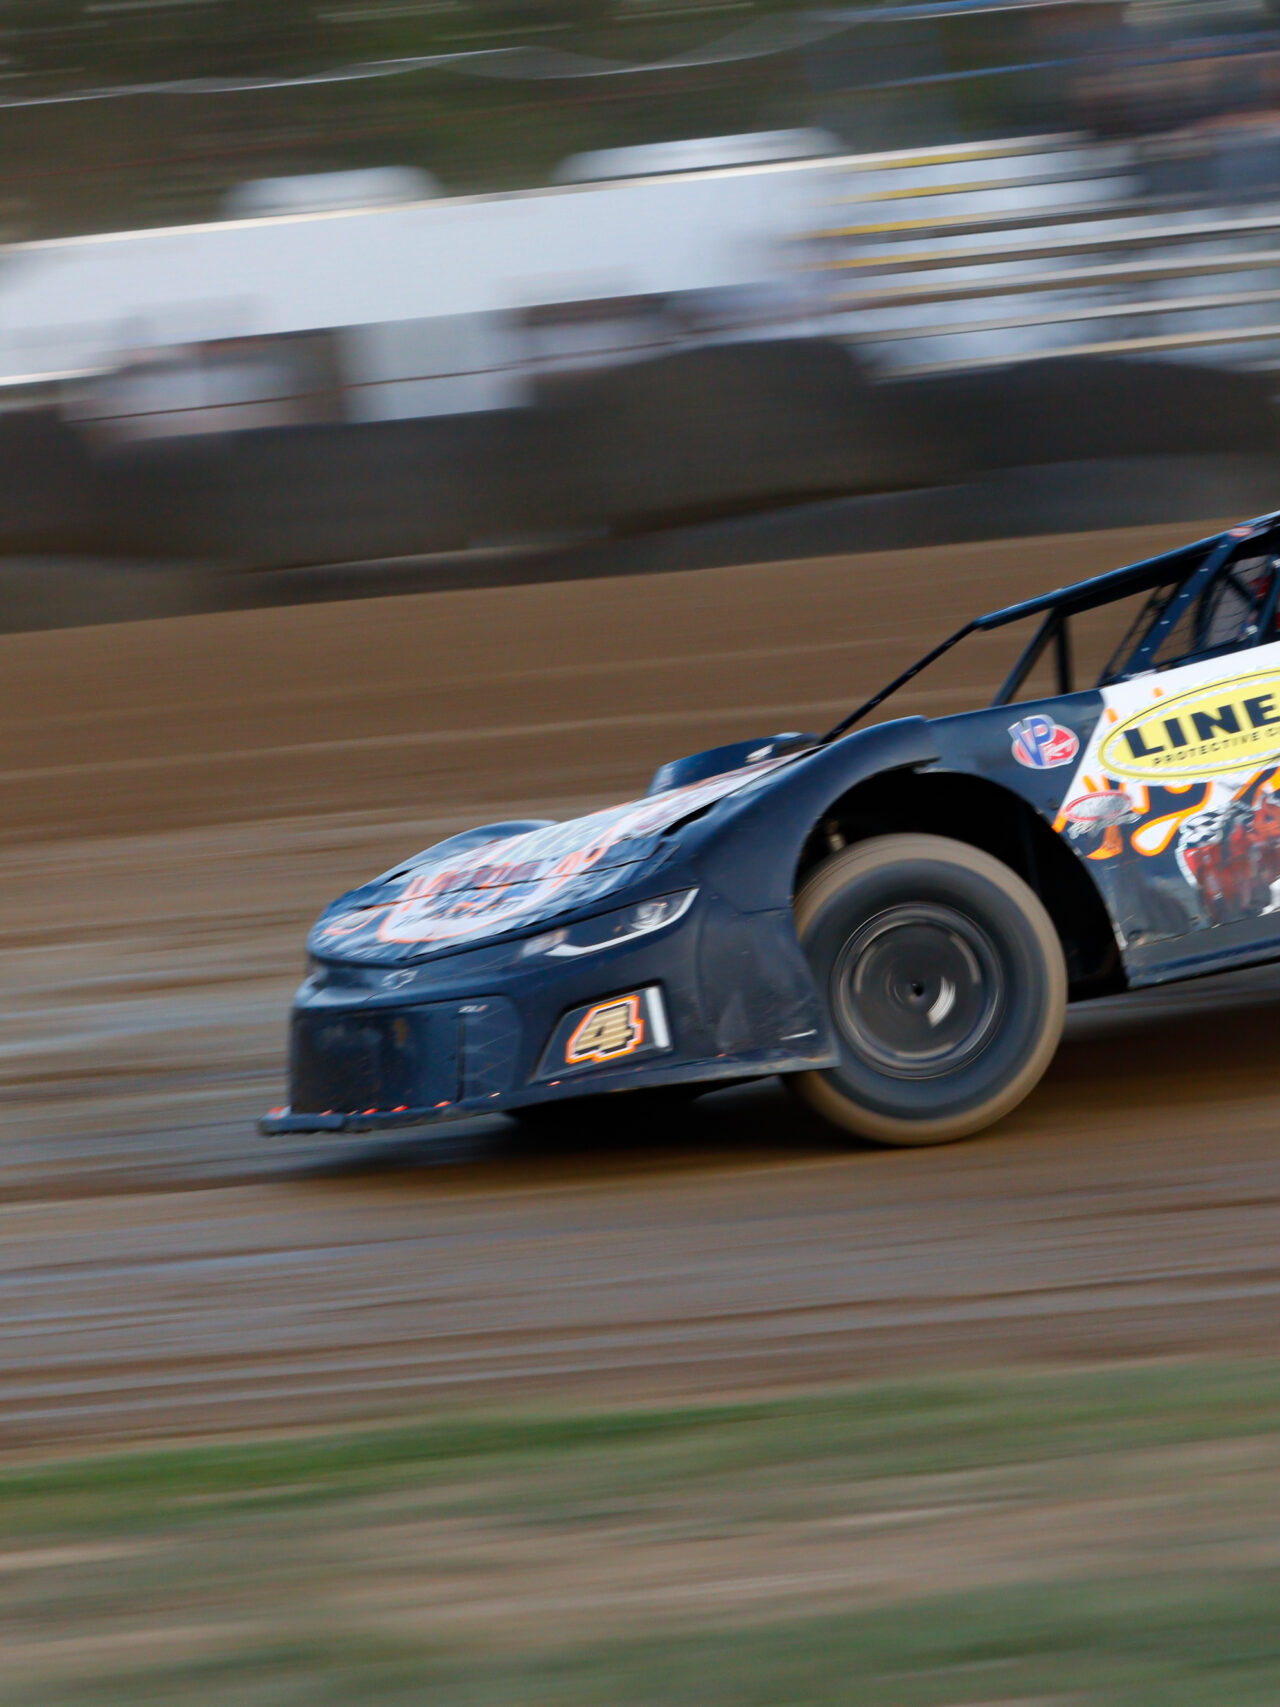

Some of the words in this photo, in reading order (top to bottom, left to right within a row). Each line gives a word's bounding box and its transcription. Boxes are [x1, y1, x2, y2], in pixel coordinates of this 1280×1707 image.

[1008, 714, 1056, 768] VP
[1152, 731, 1260, 766] PROTECTIVE
[568, 996, 643, 1062] 4
